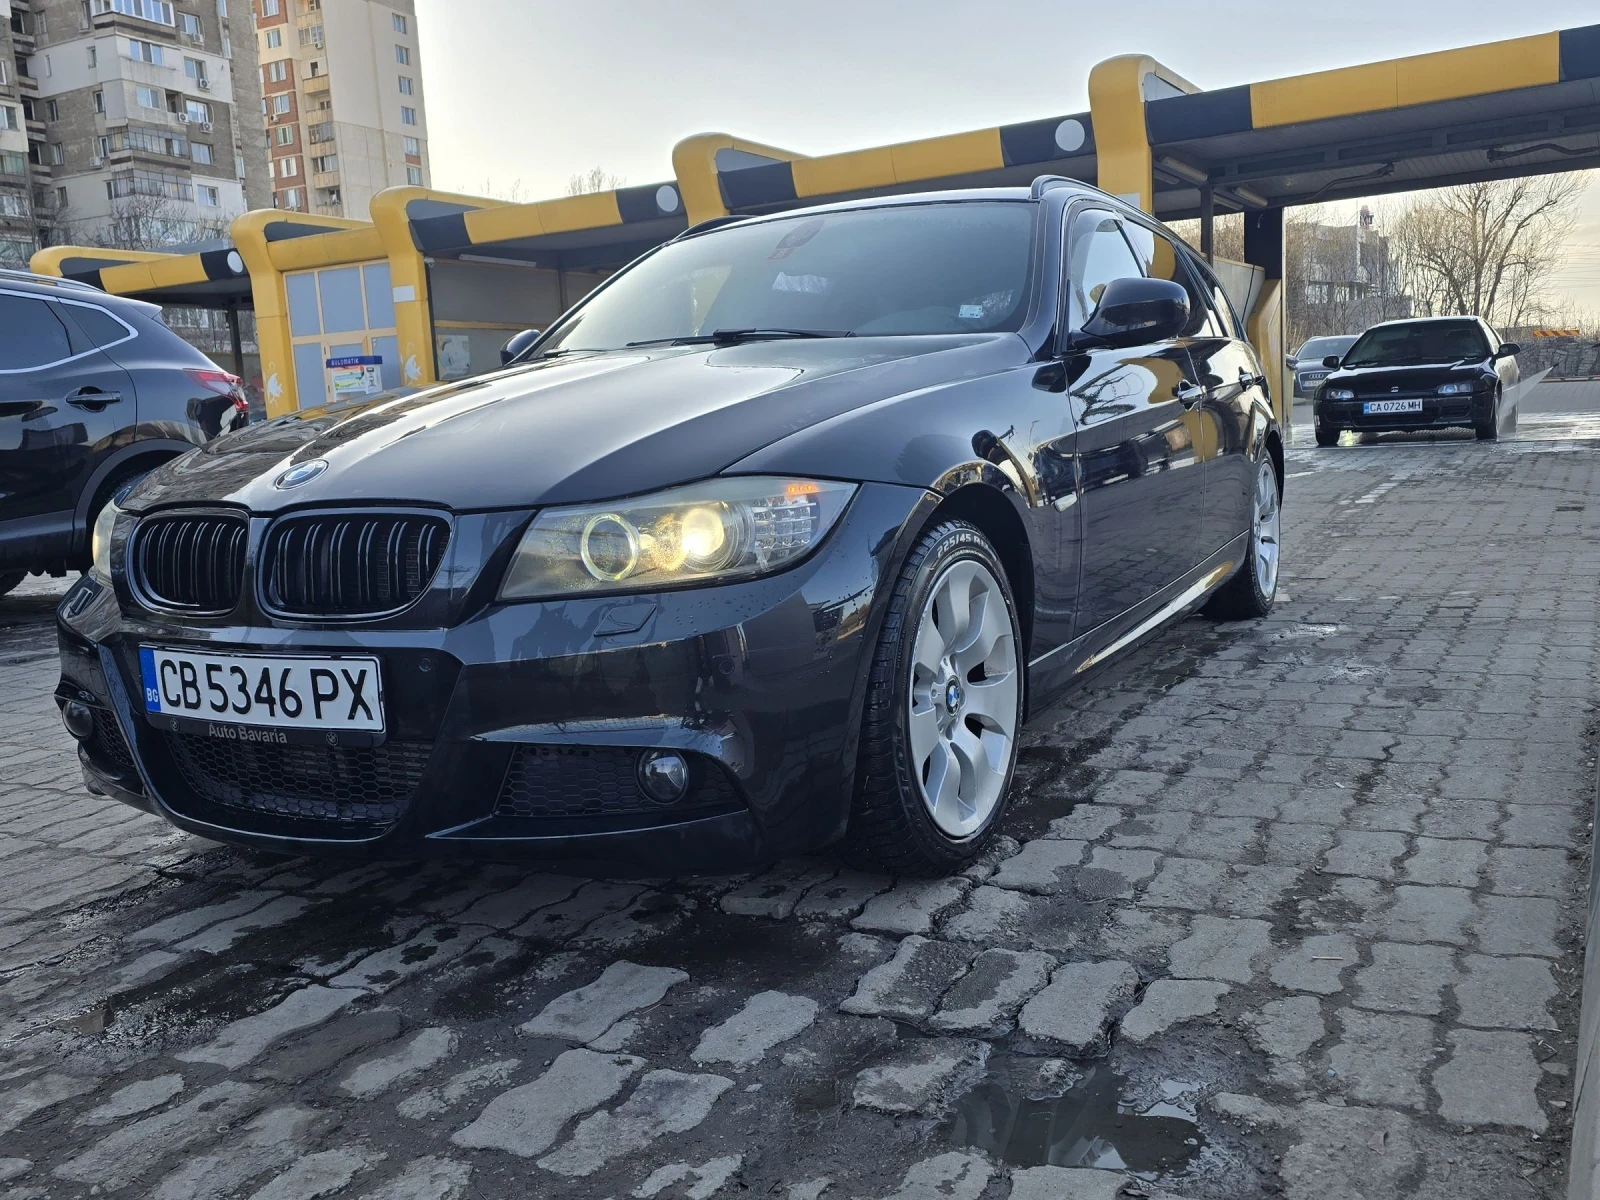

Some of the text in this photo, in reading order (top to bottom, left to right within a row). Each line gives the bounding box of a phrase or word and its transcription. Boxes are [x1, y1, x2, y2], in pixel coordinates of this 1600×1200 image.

[1383, 402, 1407, 411] 0726
[937, 533, 972, 558] 225/45
[146, 687, 159, 702] BG
[160, 659, 374, 721] CB 5346 PX
[208, 722, 288, 744] Auto Bavaria
